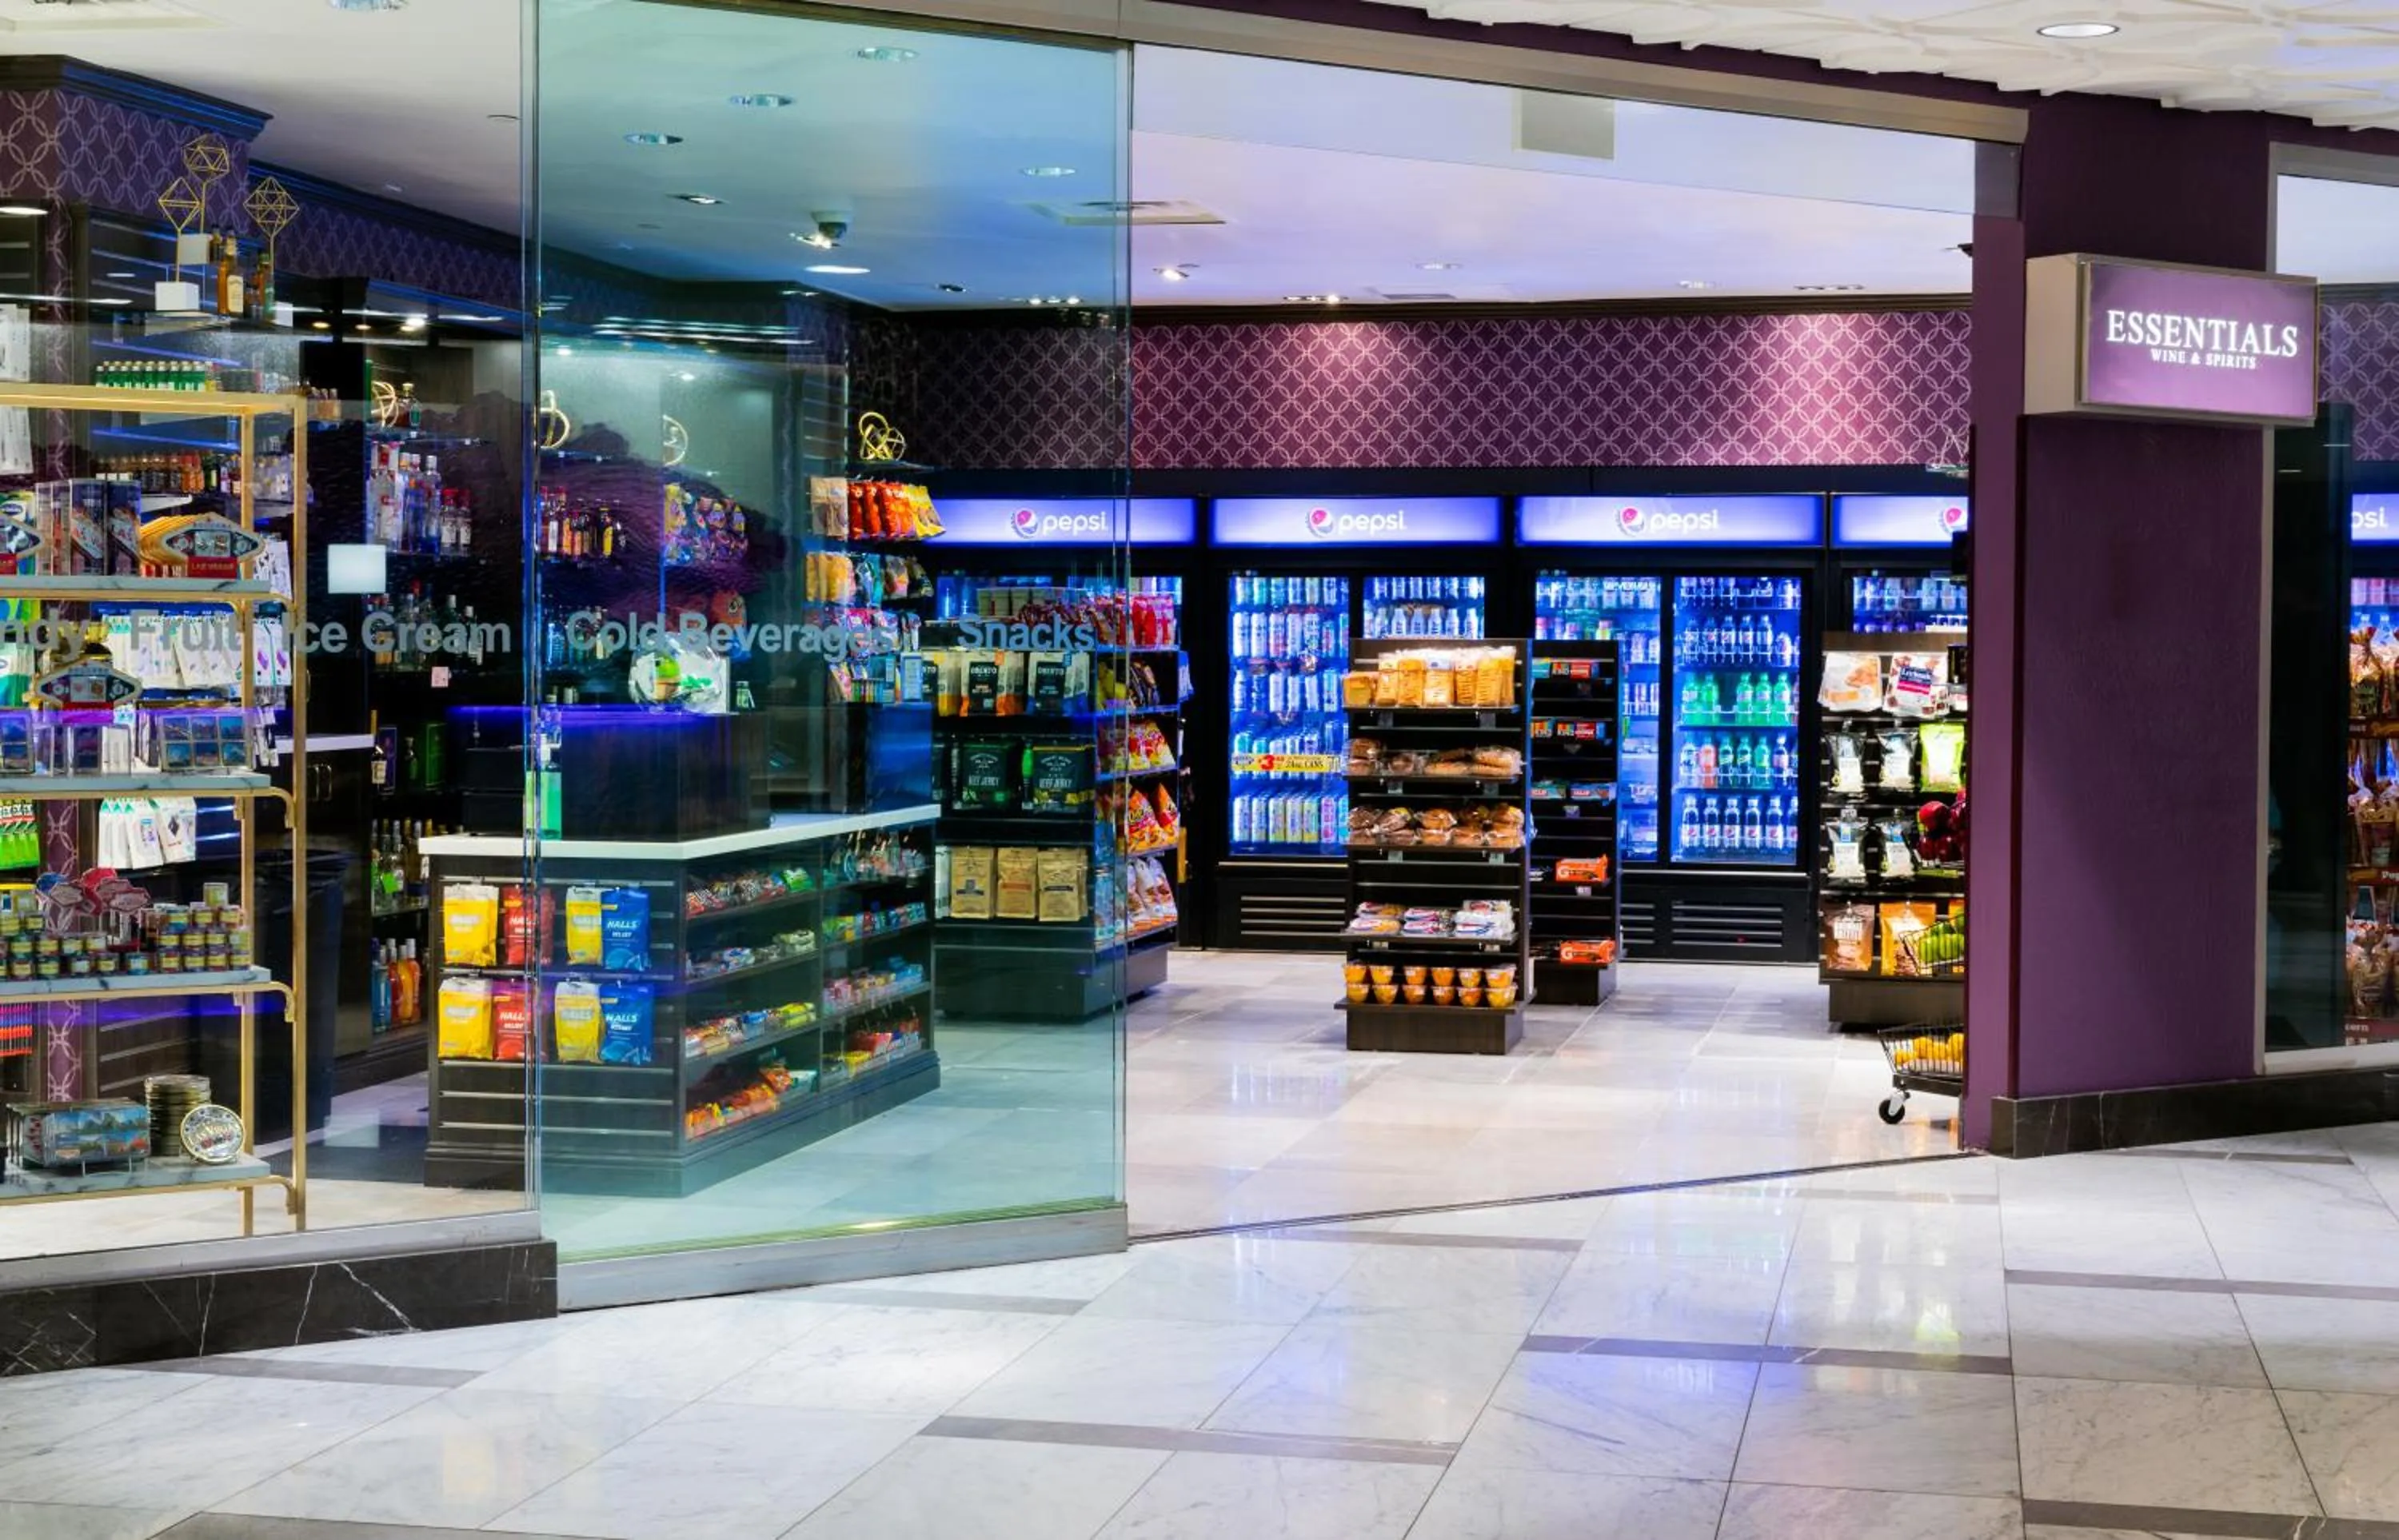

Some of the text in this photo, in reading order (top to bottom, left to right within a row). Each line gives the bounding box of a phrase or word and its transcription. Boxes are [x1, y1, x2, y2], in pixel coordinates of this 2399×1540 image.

[2106, 309, 2298, 357] ESSENTIALS
[2151, 348, 2257, 369] WINE & SPIRITS
[1042, 511, 1107, 537] pepsi
[1339, 509, 1403, 536] pepsi
[1651, 509, 1718, 534] pepsi
[2352, 506, 2385, 529] psi
[0, 608, 90, 663] ndy
[281, 611, 511, 653] Ice Cream
[566, 611, 894, 662] Cold Beverages
[957, 611, 1095, 651] Snacks
[607, 920, 637, 929] HALLS
